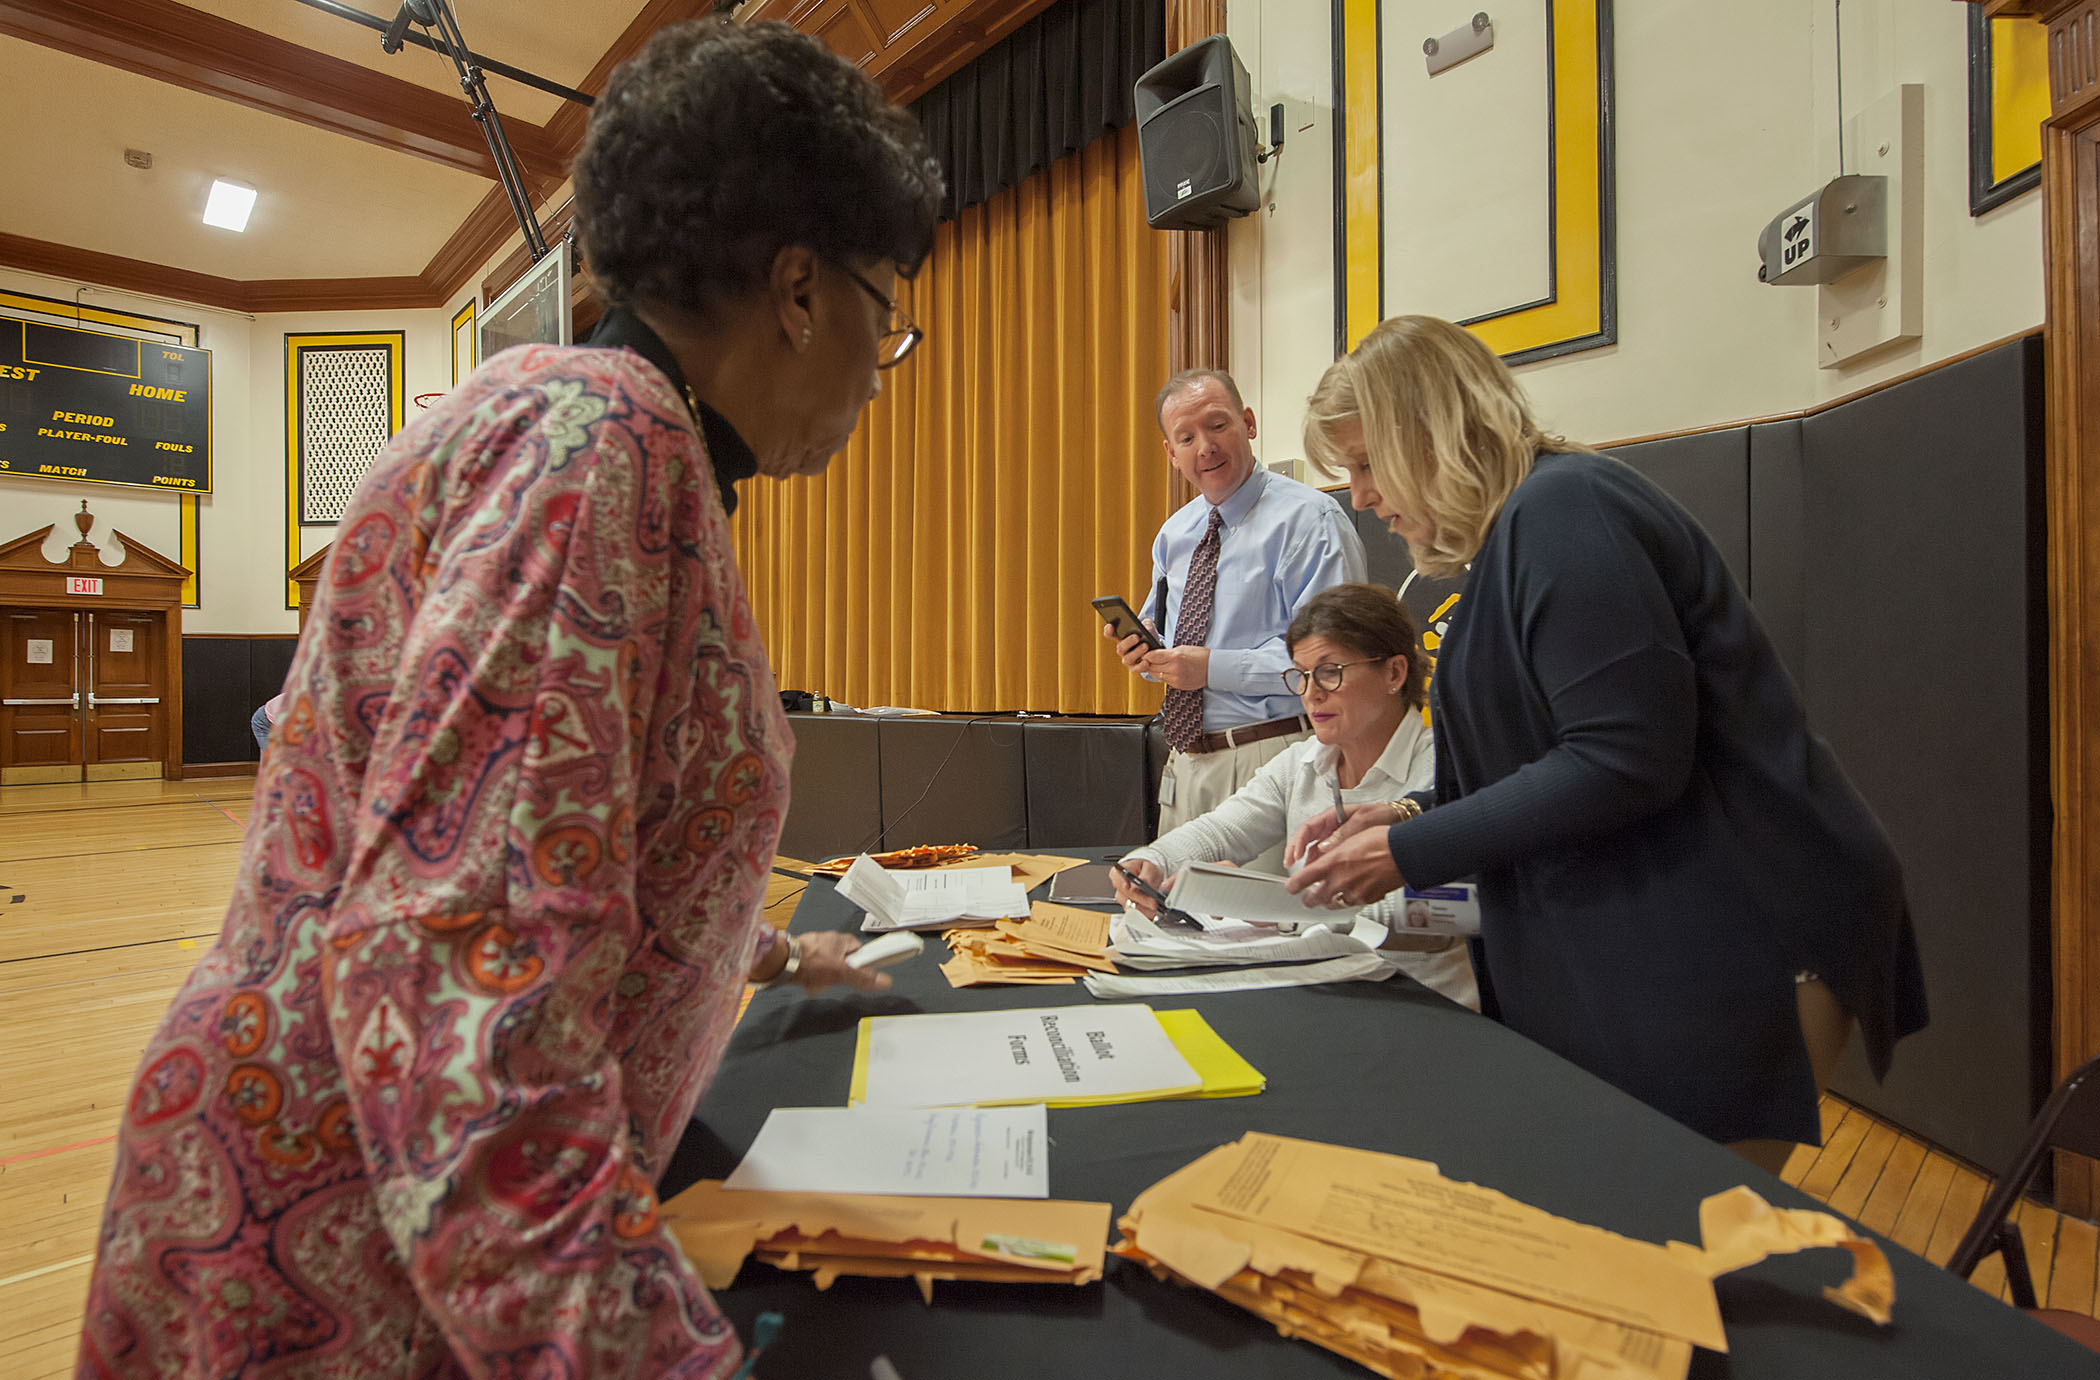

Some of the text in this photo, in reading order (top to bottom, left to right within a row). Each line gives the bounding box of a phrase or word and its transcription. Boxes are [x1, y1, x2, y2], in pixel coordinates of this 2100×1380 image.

[1784, 238, 1810, 265] UP
[162, 351, 185, 362] TOL
[129, 384, 187, 402] HOME
[52, 410, 114, 428] PERIOD
[37, 428, 128, 446] PLAYER-FOUL
[155, 441, 193, 454] FOULS
[39, 464, 87, 477] MATCH
[152, 475, 195, 487] POINTS
[74, 579, 98, 593] EXIT
[1008, 1035, 1031, 1065] Forms
[1040, 1015, 1080, 1083] Reconciliation
[1086, 1031, 1115, 1060] Ballot
